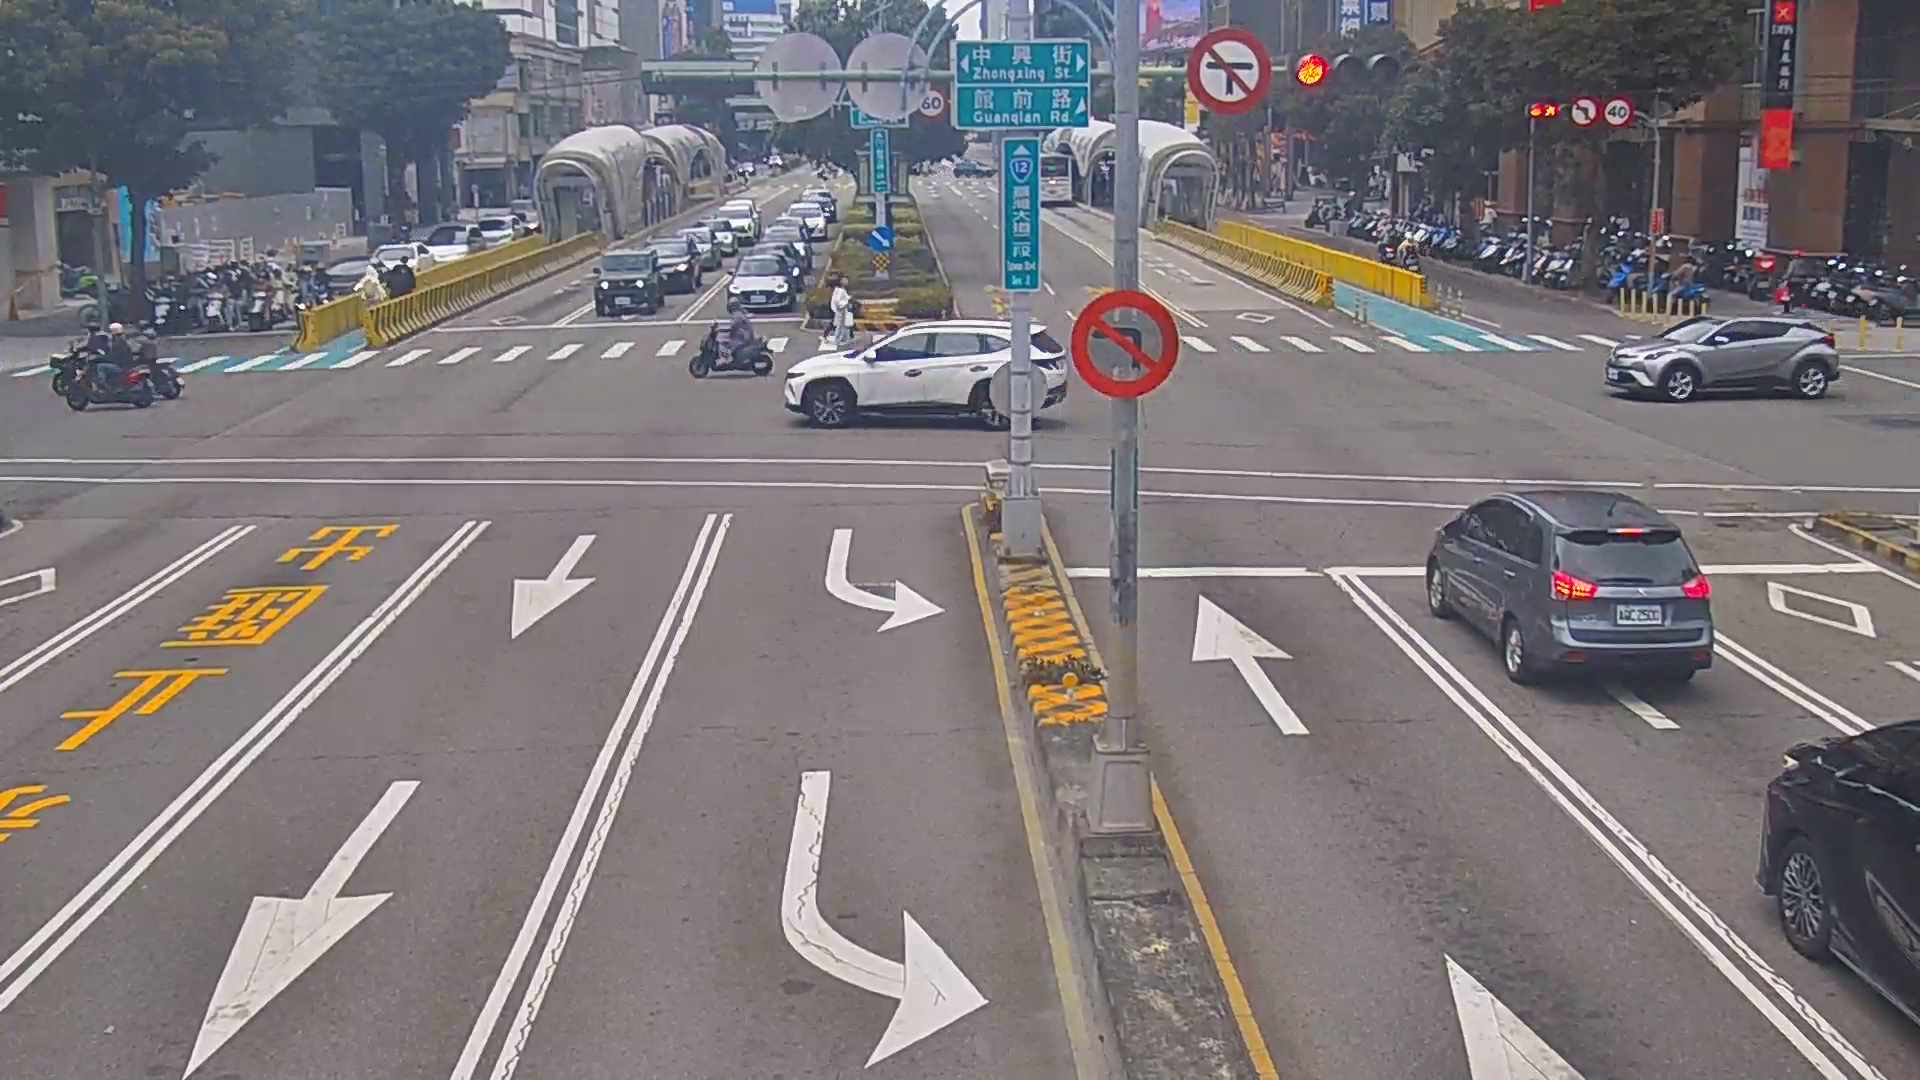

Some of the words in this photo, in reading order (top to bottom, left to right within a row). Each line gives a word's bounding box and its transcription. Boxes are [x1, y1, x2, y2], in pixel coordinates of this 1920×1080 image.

[973, 45, 1072, 65] 中興街
[973, 67, 1045, 82] Zhongxing
[921, 97, 941, 110] 60
[974, 89, 1072, 109] 館前路
[974, 111, 1040, 125] Guanqian
[1607, 105, 1627, 119] 40
[1015, 162, 1027, 172] 12
